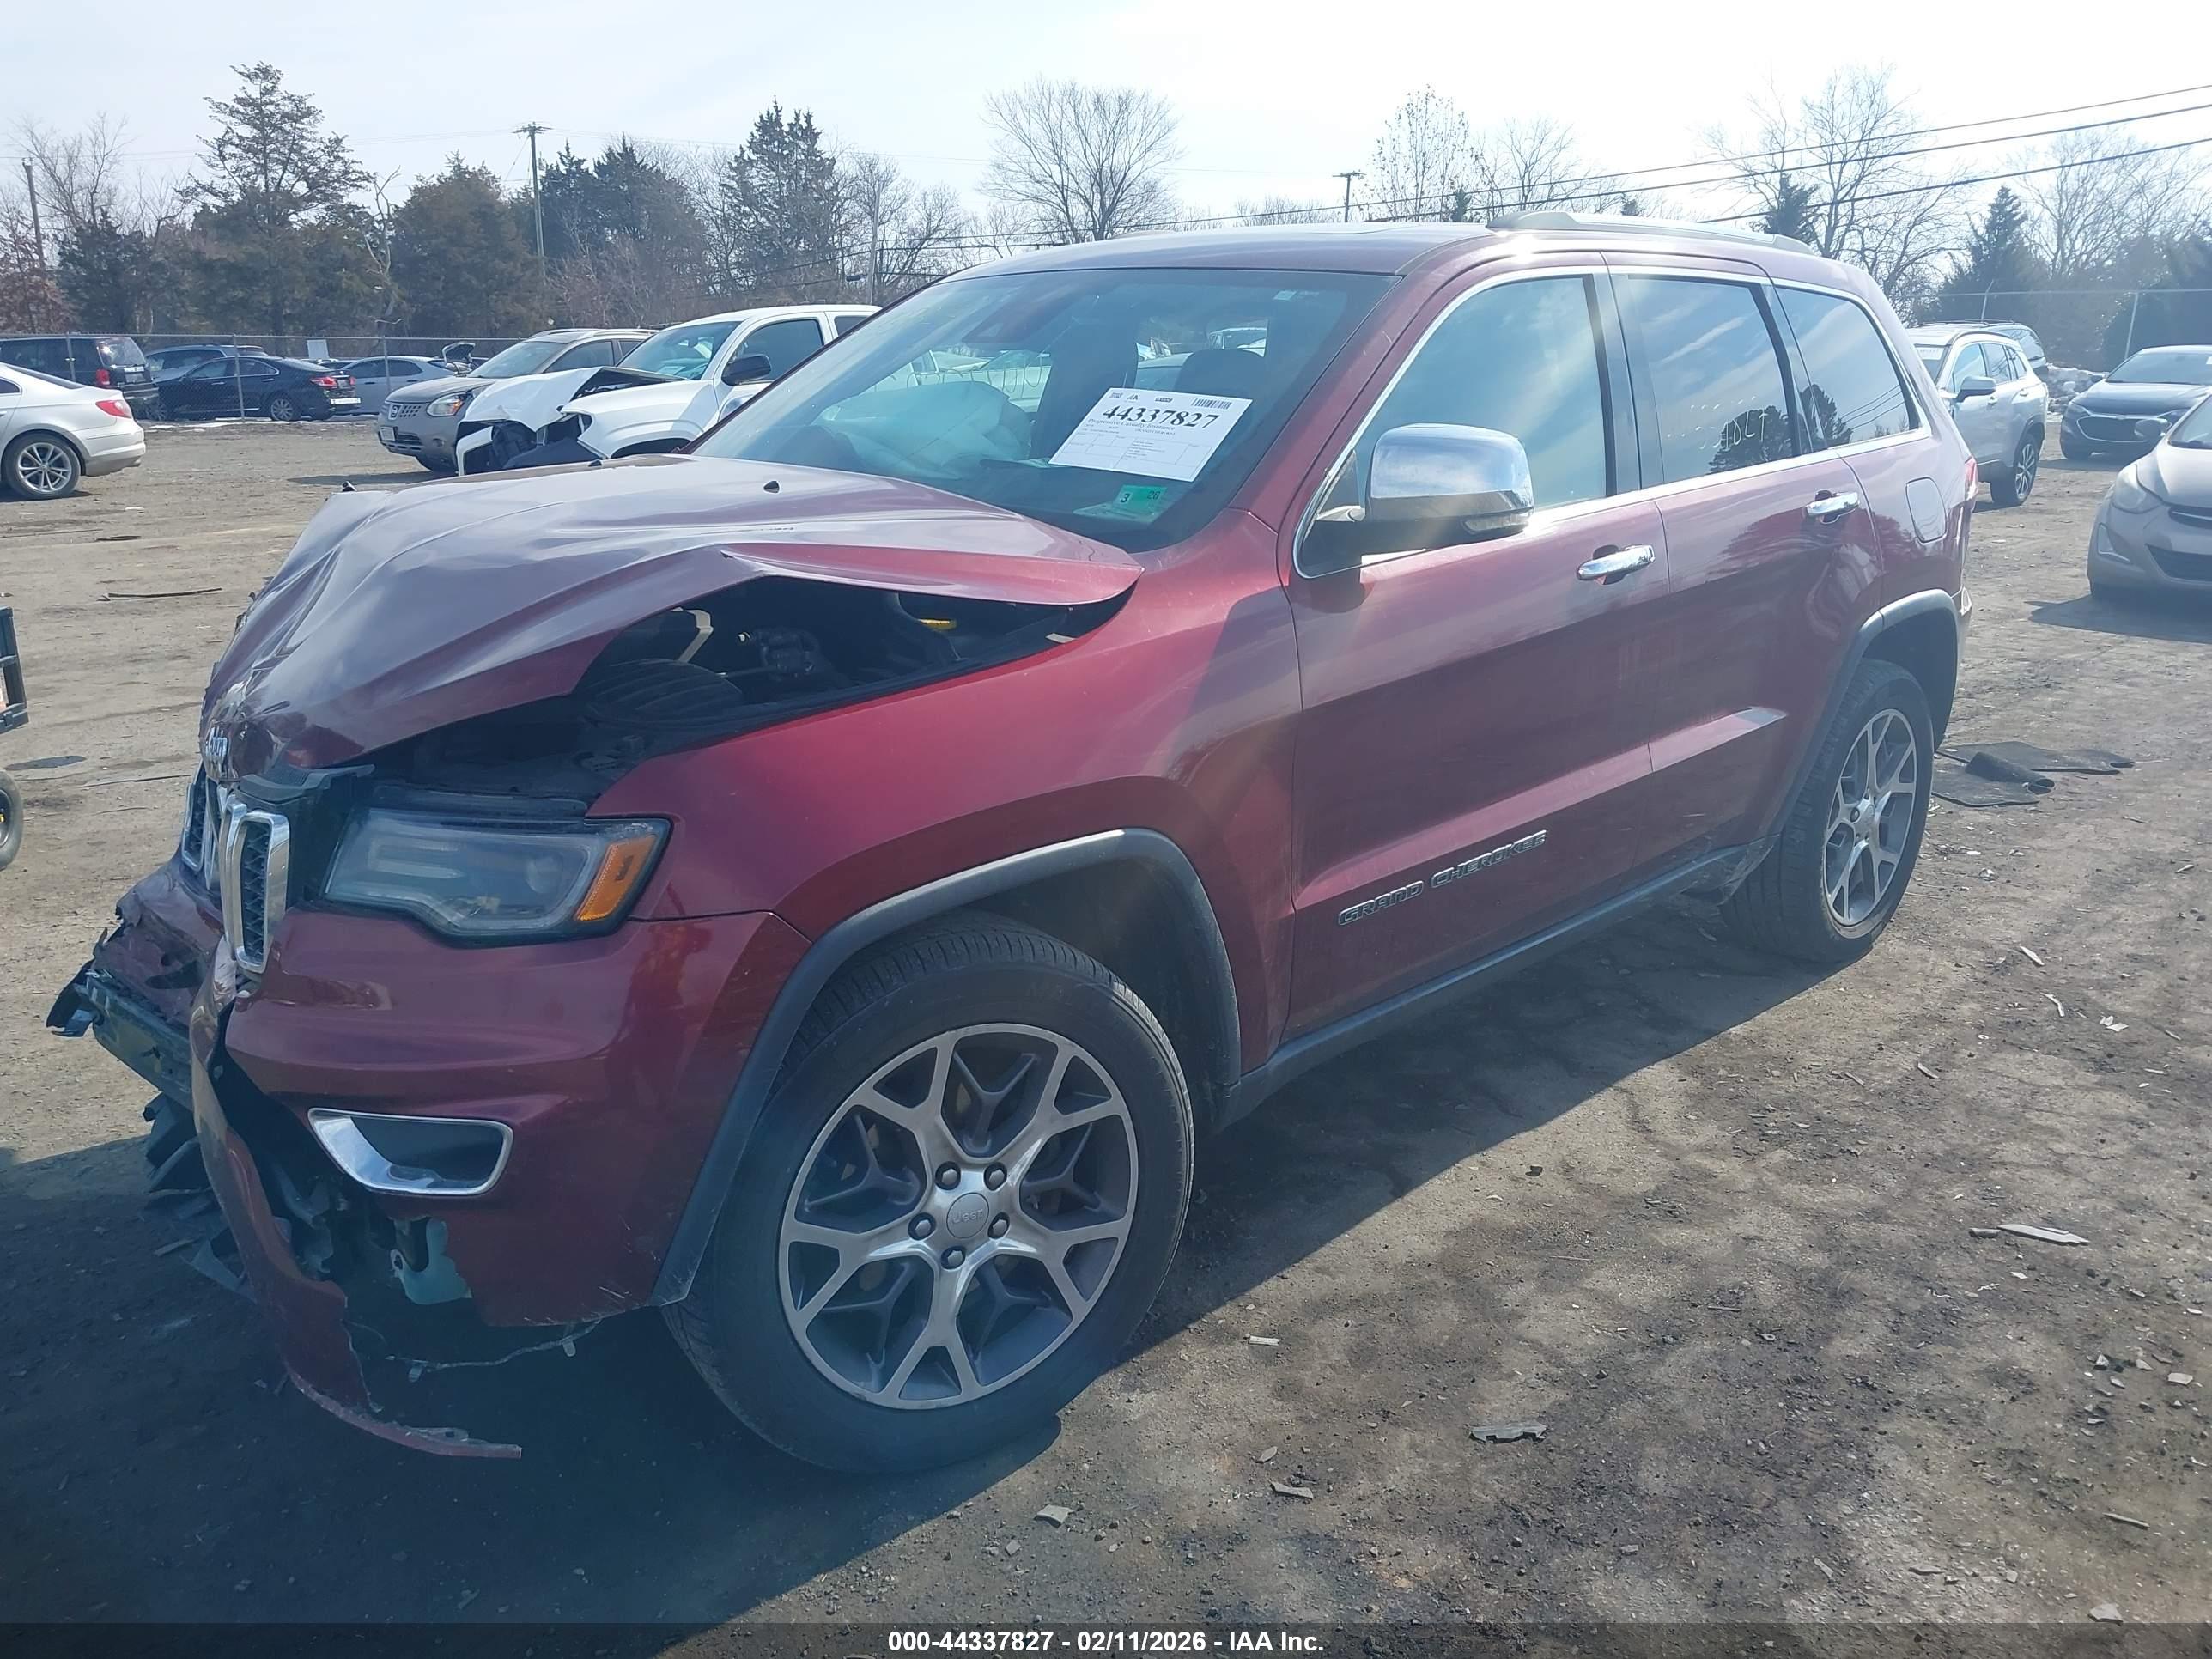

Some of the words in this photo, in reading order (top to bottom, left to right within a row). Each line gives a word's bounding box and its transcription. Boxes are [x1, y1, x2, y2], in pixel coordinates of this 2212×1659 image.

[1103, 405, 1220, 428] 44337827
[1121, 493, 1131, 503] 3
[1338, 879, 1425, 926] GRAND
[1431, 830, 1547, 889] CHEROKEE
